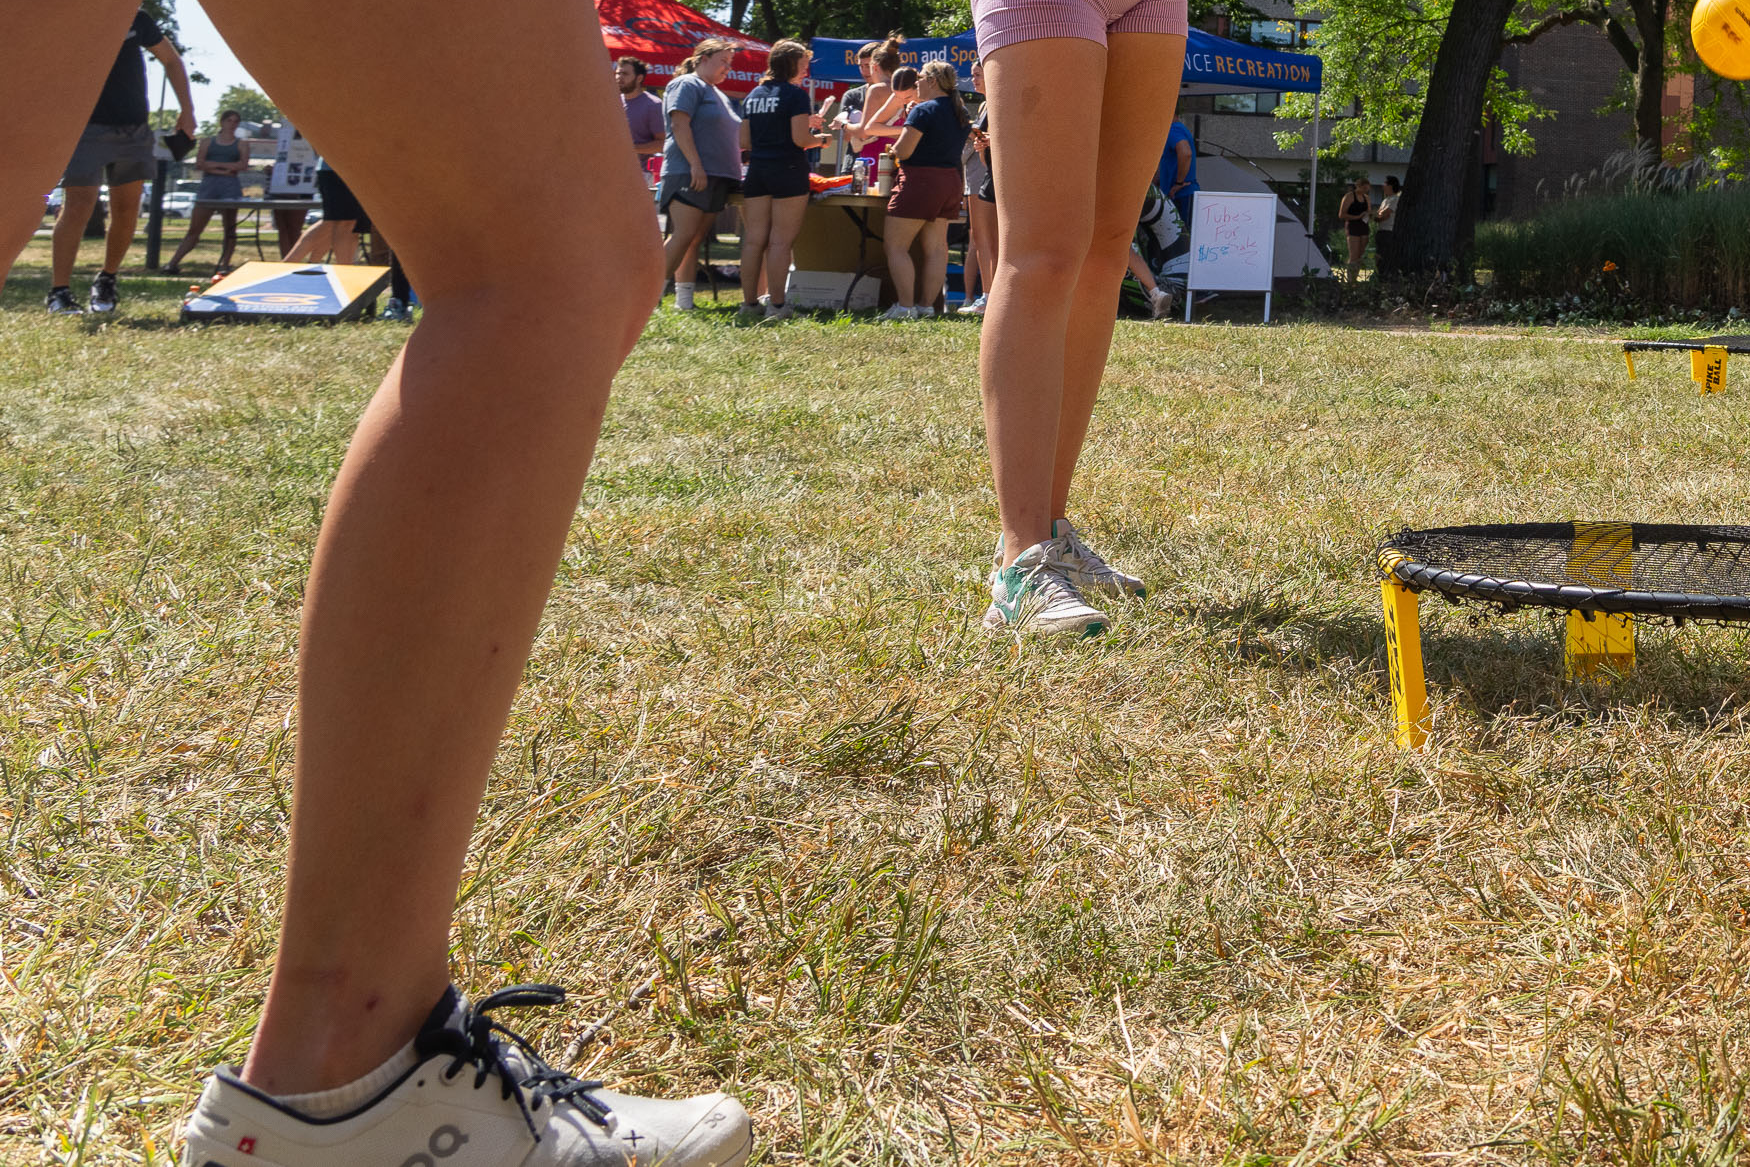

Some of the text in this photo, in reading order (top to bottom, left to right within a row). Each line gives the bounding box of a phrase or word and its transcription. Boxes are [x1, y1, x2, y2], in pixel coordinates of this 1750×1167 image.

[921, 45, 947, 62] and
[1215, 55, 1311, 83] RECREATION
[746, 96, 780, 115] STAFF
[1712, 358, 1722, 386] BALL
